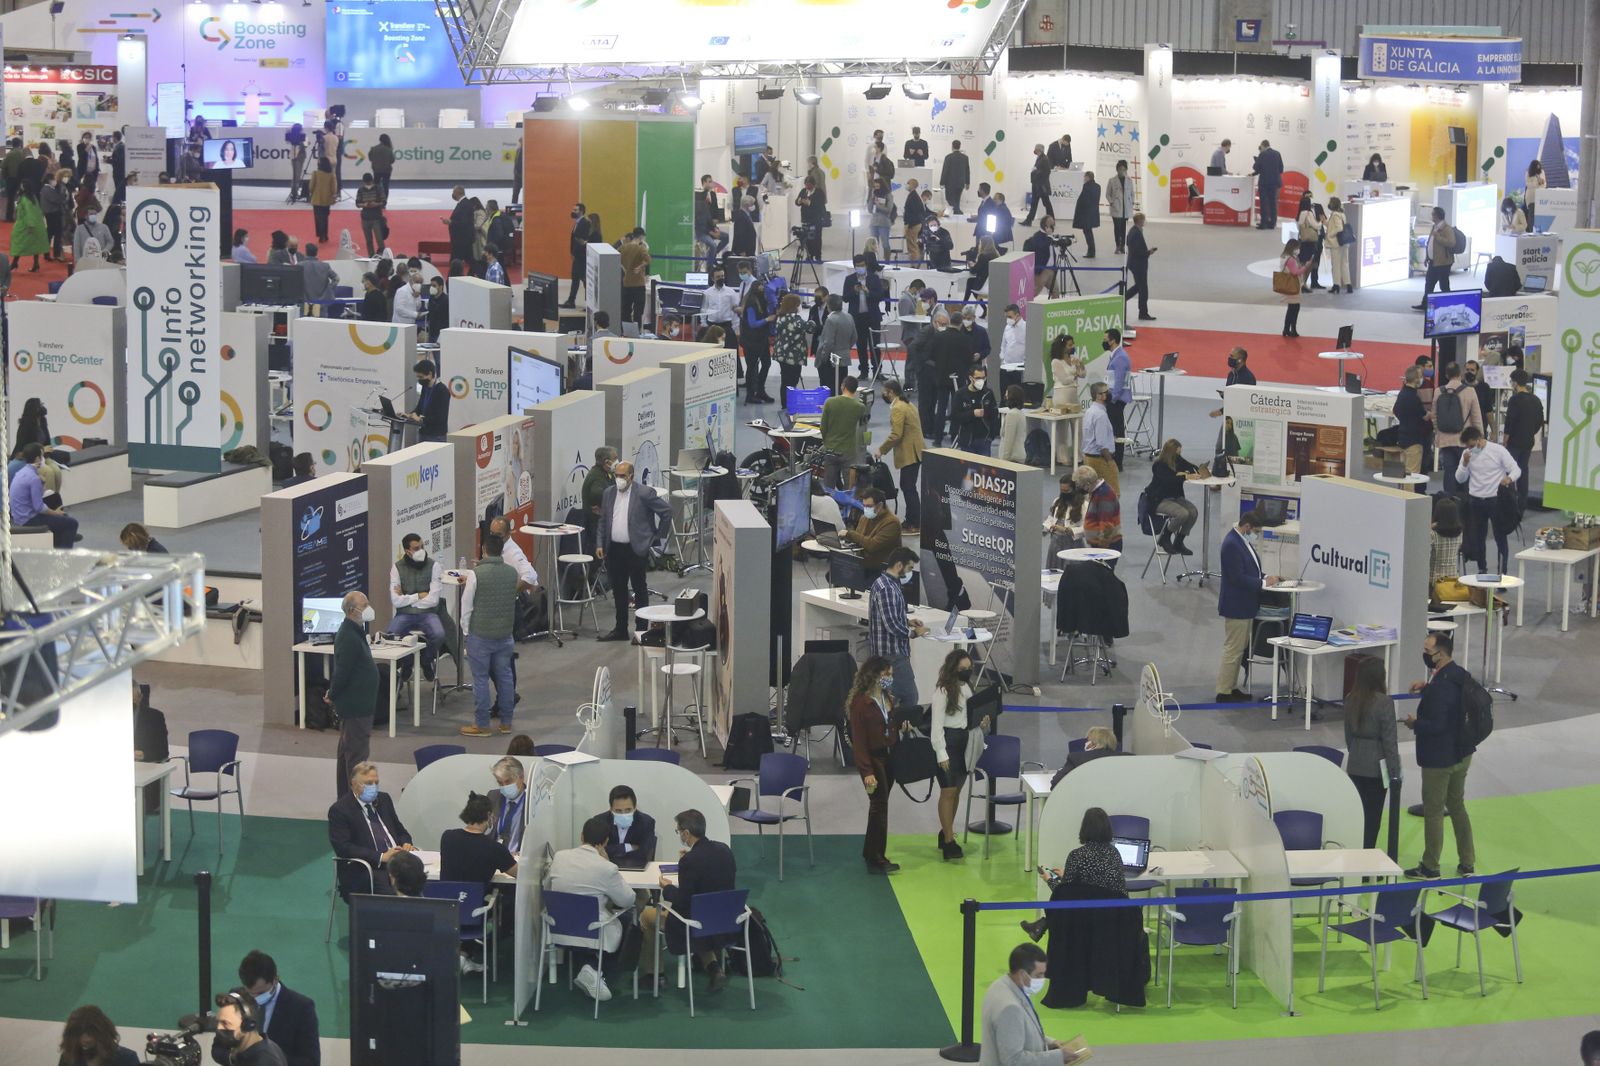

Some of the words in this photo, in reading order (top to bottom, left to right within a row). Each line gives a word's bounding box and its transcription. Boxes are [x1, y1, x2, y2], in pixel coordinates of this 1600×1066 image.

[234, 21, 306, 38] Boosting
[234, 35, 276, 49] Zone
[1391, 46, 1433, 59] XUNTA
[1389, 60, 1404, 71] DE
[1408, 61, 1461, 74] GALICIA
[1476, 65, 1483, 75] A
[1485, 65, 1495, 75] LA
[71, 69, 113, 81] CSIC
[393, 146, 444, 164] osting
[449, 147, 492, 160] Zone
[1523, 247, 1541, 255] start
[1522, 255, 1548, 265] galicia
[185, 206, 211, 373] networking
[161, 287, 182, 343] Info
[1076, 314, 1122, 333] PASIVA
[1046, 324, 1069, 342] BIO
[37, 352, 68, 363] Demo
[70, 353, 104, 366] Center
[37, 362, 64, 373] TRL7
[474, 377, 507, 390] Demo
[474, 388, 503, 401] TRL7
[1250, 393, 1292, 408] Cátedra
[406, 464, 439, 491] mykeys
[973, 472, 1015, 495] DIAS2P
[1002, 498, 1015, 508] para
[982, 516, 989, 524] de
[962, 527, 1014, 554] StreetQR
[1311, 543, 1368, 574] Cultural
[1373, 558, 1391, 579] Fit
